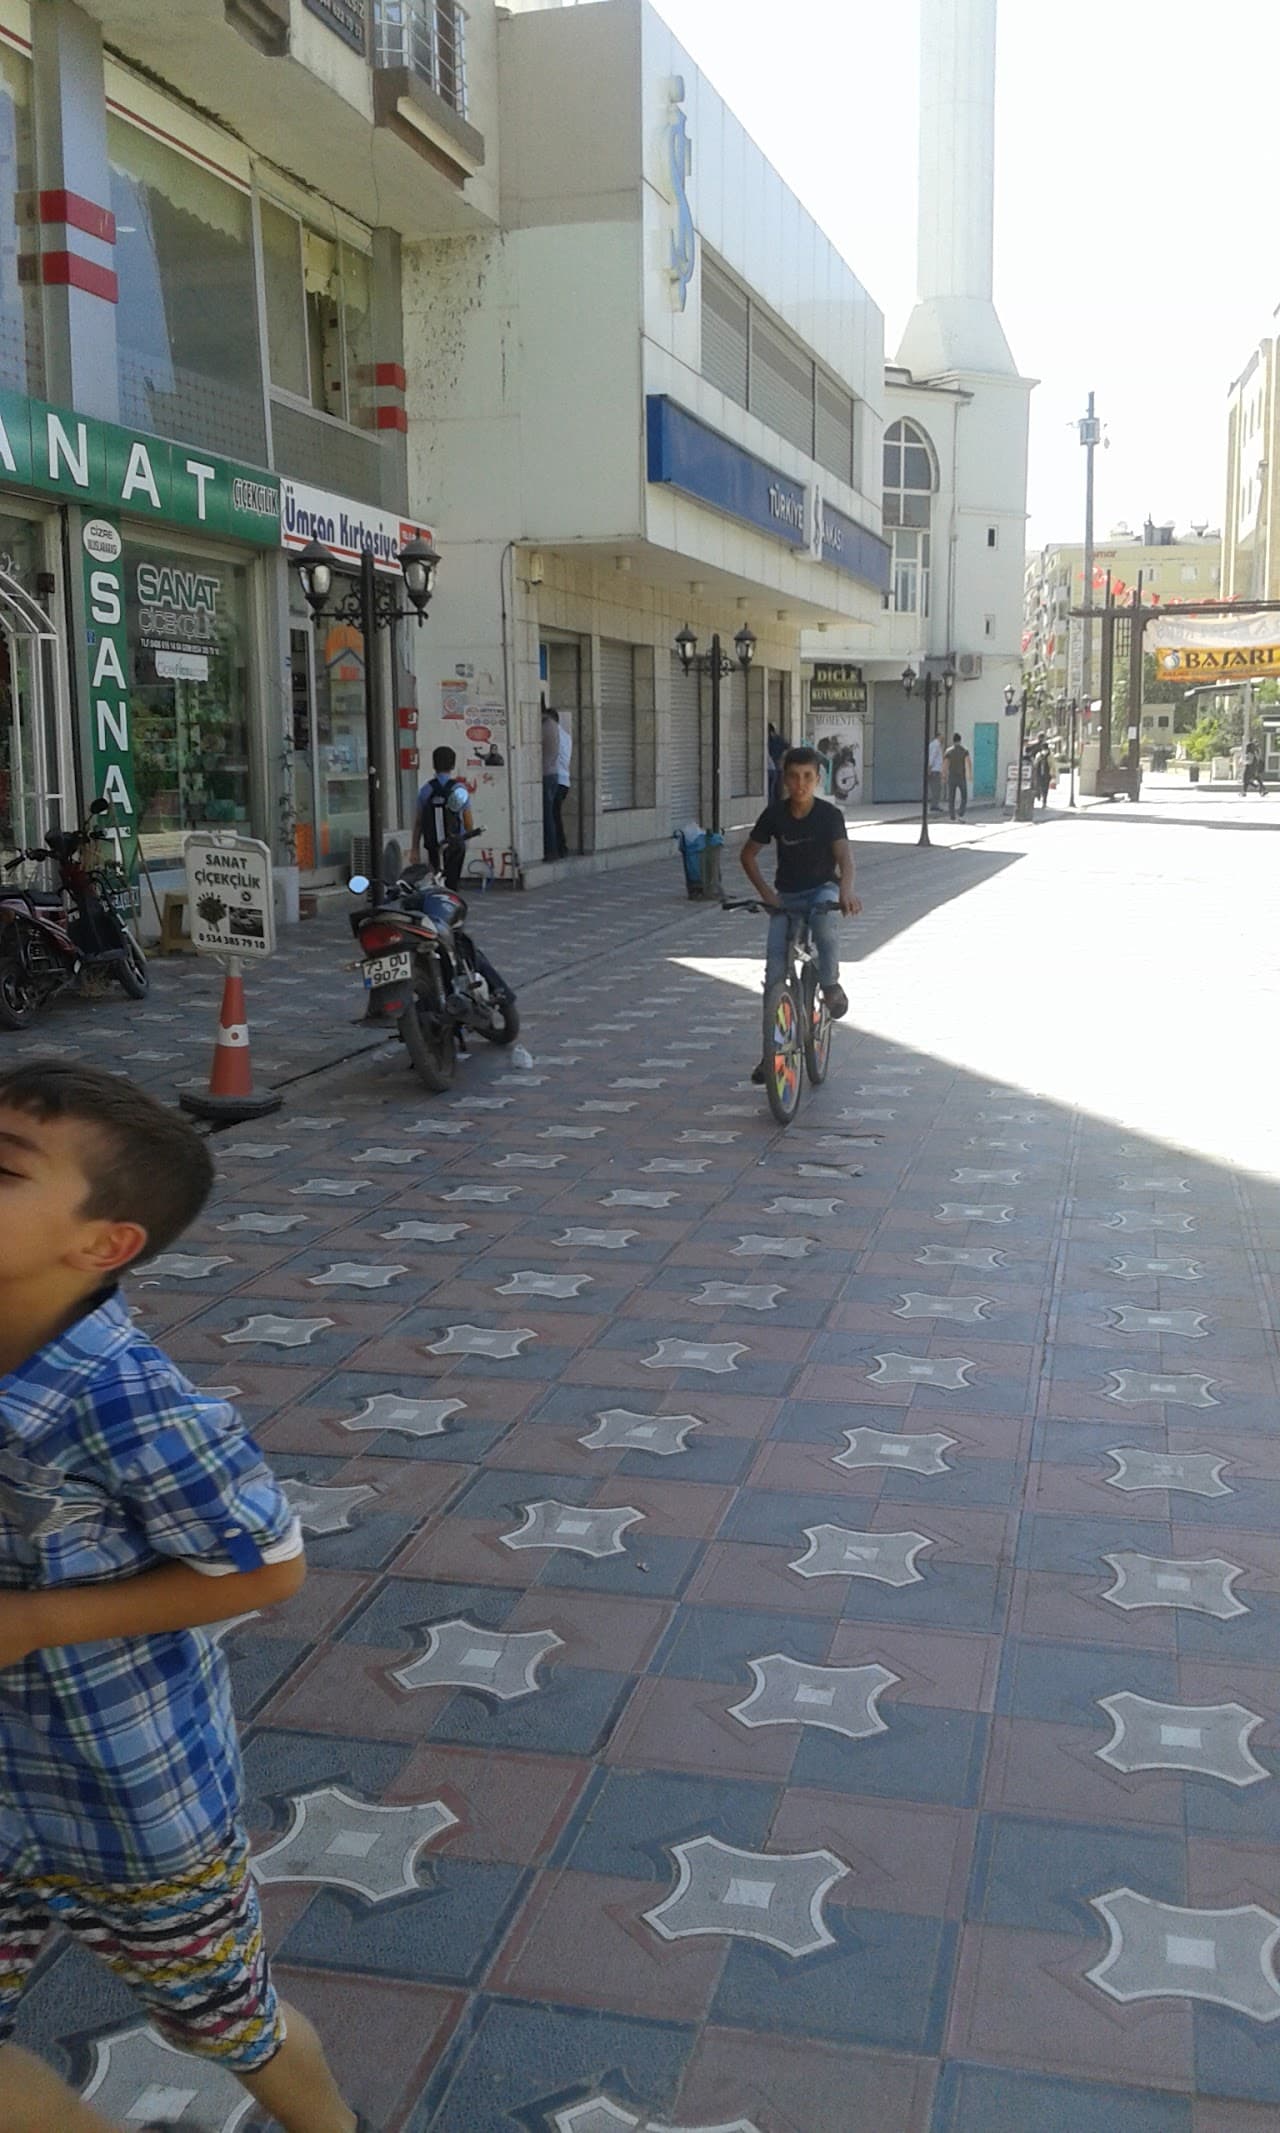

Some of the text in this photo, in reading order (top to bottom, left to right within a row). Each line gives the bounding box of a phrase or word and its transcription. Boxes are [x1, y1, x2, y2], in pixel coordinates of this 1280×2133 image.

[285, 486, 398, 566] Ümran Kırtasiye
[136, 562, 220, 616] SANAT
[206, 853, 247, 870] SANAT
[195, 868, 260, 890] ÇİÇEKÇİLİK
[206, 934, 222, 943] 534
[241, 938, 253, 947] 79
[366, 953, 408, 976] 73 DU
[374, 967, 400, 985] 907
